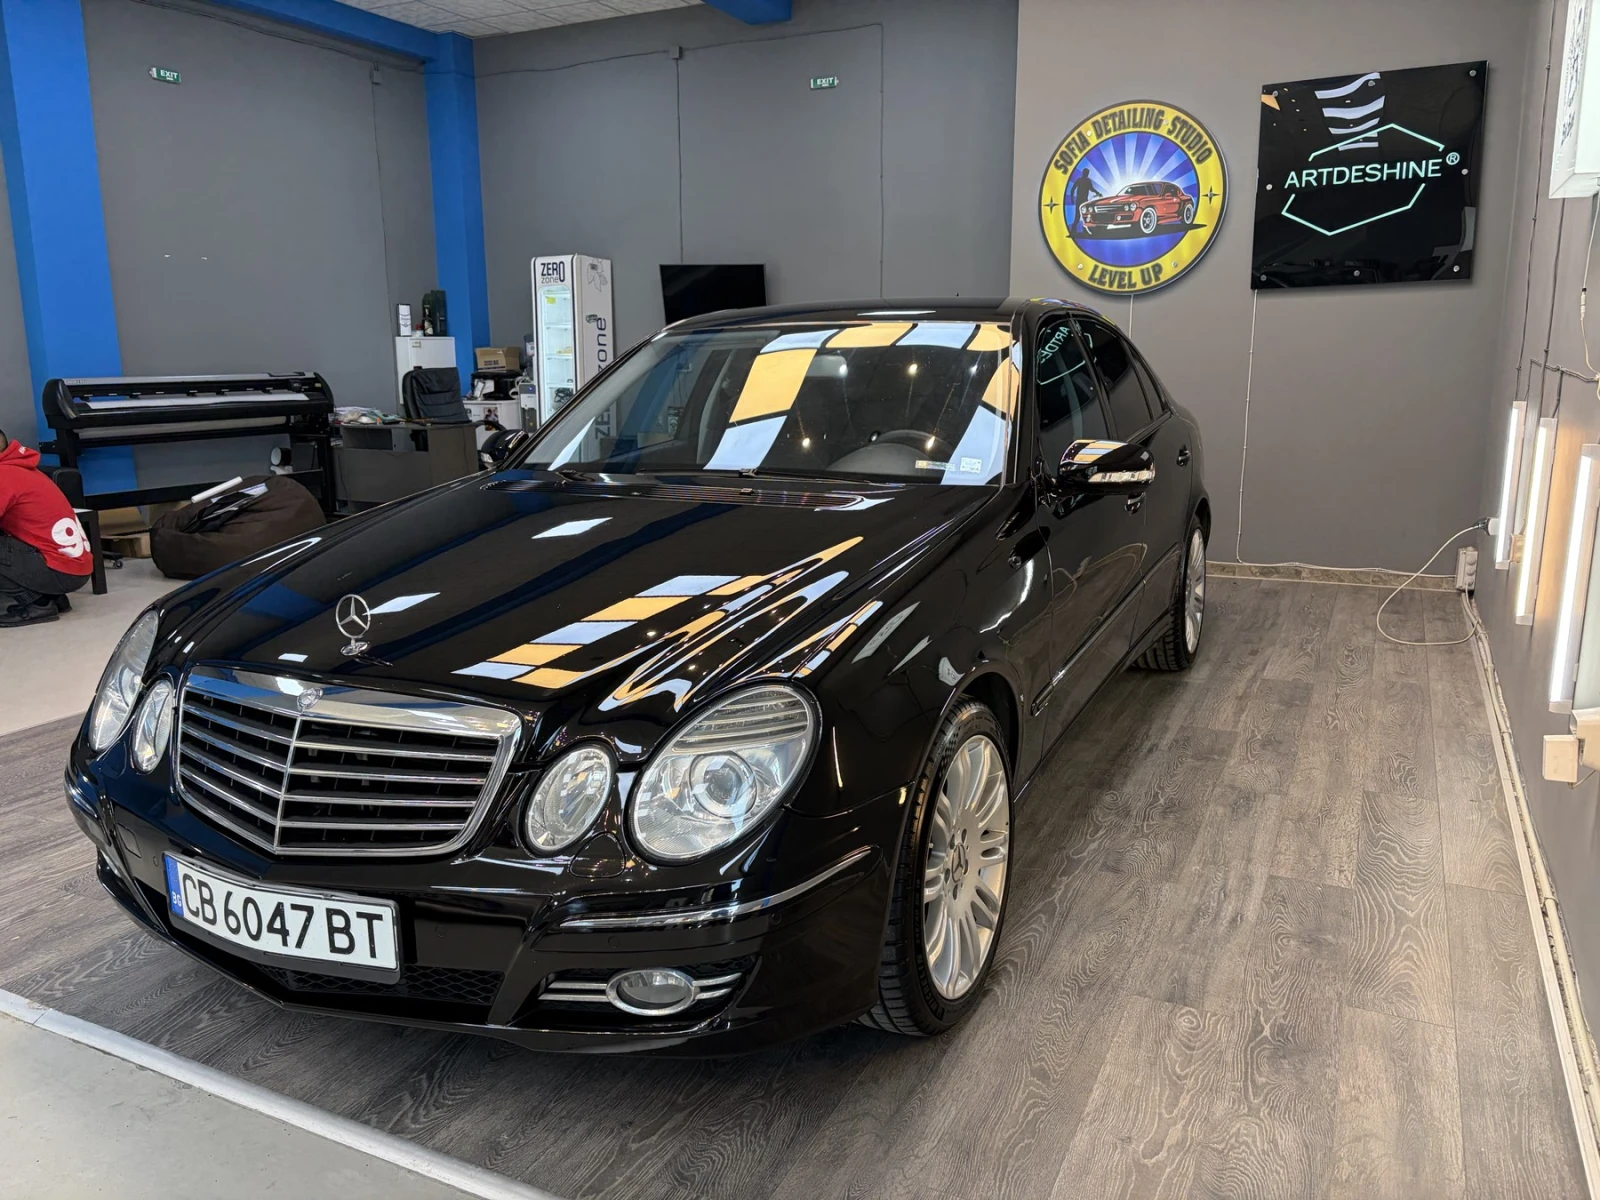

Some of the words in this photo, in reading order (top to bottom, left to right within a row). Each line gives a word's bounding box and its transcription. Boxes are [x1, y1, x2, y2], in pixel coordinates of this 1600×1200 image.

[160, 69, 178, 79] EXIT
[816, 77, 834, 85] EXIT
[1054, 131, 1091, 175] SOFIA
[1091, 107, 1166, 143] DETAILING
[1166, 115, 1214, 165] STUDIO
[540, 261, 566, 282] ZERO
[540, 276, 559, 284] zone
[1087, 264, 1137, 289] LEVEL
[1140, 263, 1163, 284] UP
[171, 891, 182, 907] BG
[182, 873, 218, 926] CB
[224, 891, 315, 950] 6047
[325, 907, 384, 960] BT
